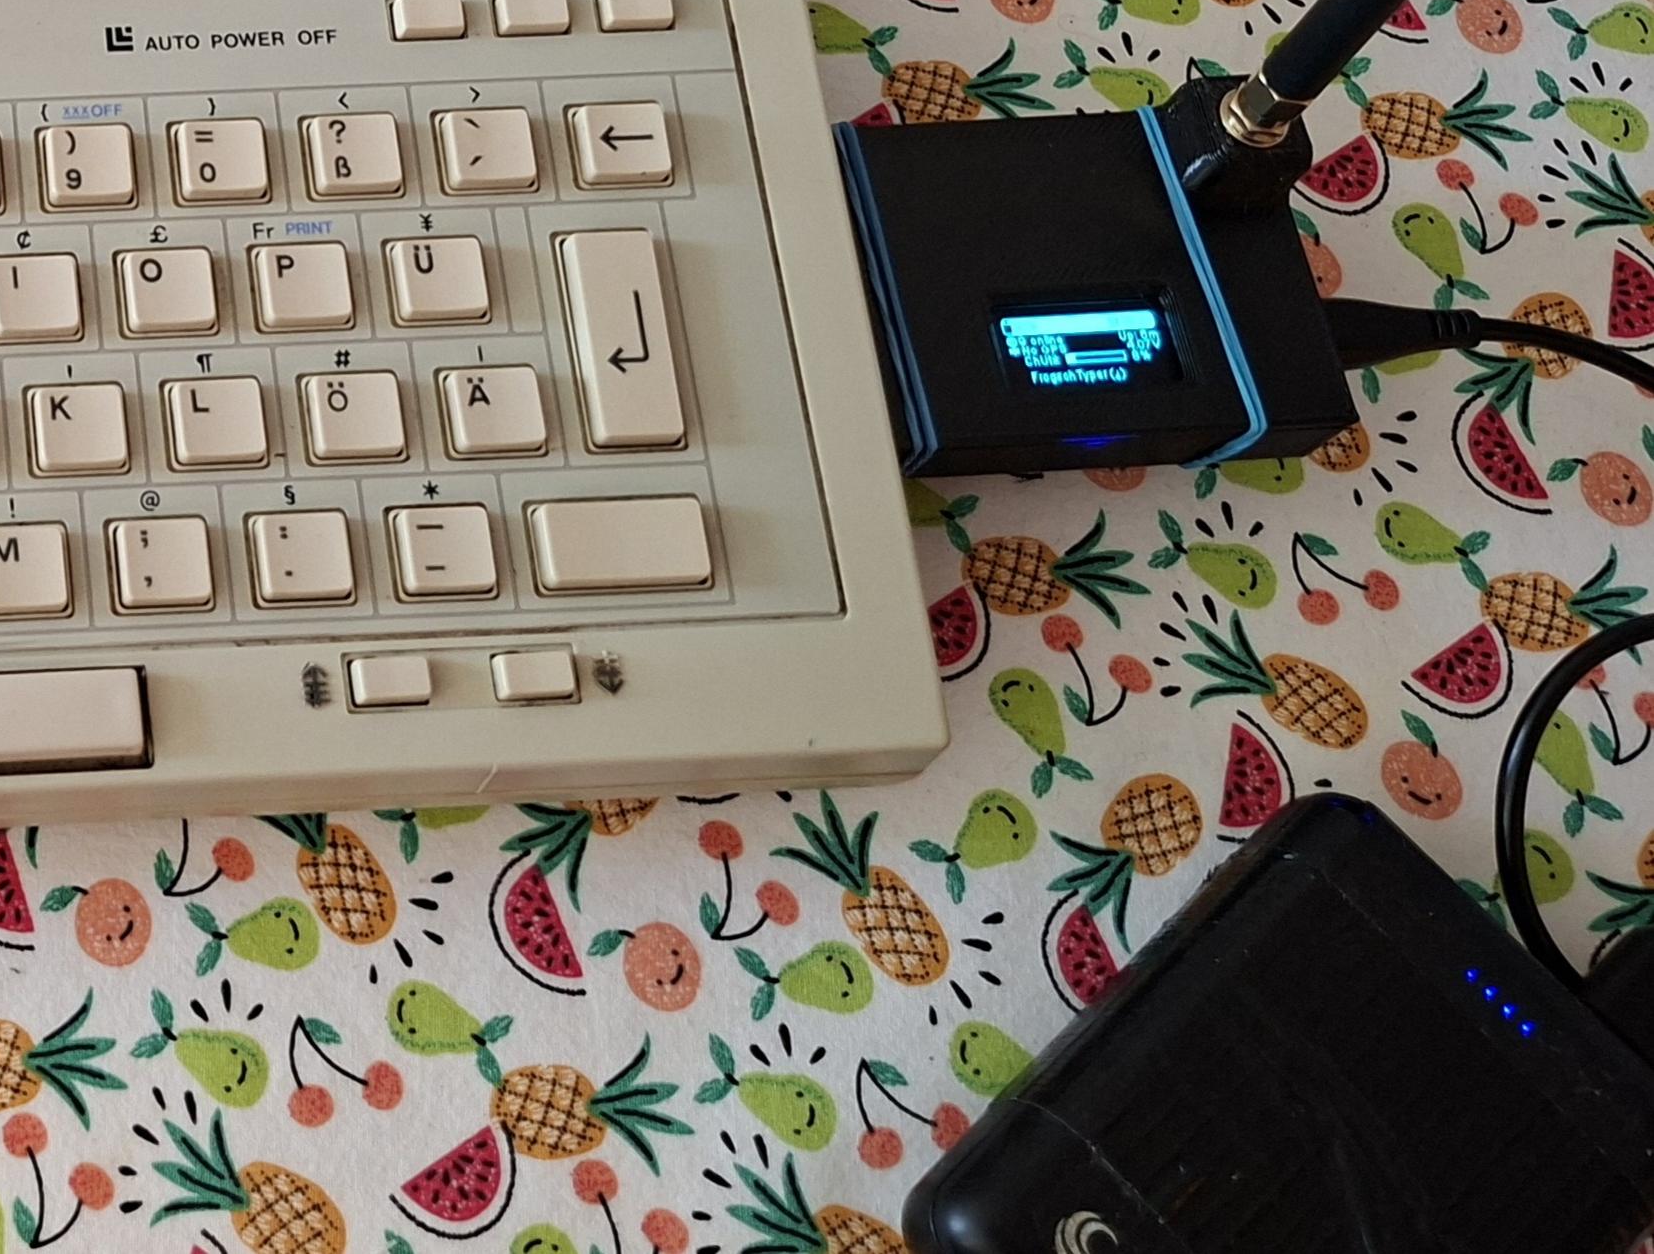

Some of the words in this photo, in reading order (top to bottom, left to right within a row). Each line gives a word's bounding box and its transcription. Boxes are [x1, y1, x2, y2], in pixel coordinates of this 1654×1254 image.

[145, 35, 200, 52] AUTO
[211, 31, 285, 48] POWER
[298, 29, 337, 45] OFF
[329, 121, 346, 144] ?
[335, 156, 352, 179] ß
[65, 169, 83, 190] 9
[253, 222, 275, 240] Fr
[285, 221, 333, 236] PRINT
[419, 213, 434, 232] ¥
[149, 226, 168, 244] £
[140, 258, 163, 283] O
[276, 255, 295, 278] P
[412, 245, 434, 274] Ü
[12, 266, 20, 289] I
[334, 349, 351, 366] #
[192, 389, 209, 412] L
[327, 381, 347, 412] Ö
[467, 377, 491, 407] Ä
[50, 396, 71, 421] K
[140, 490, 161, 511] @
[284, 485, 297, 506] §
